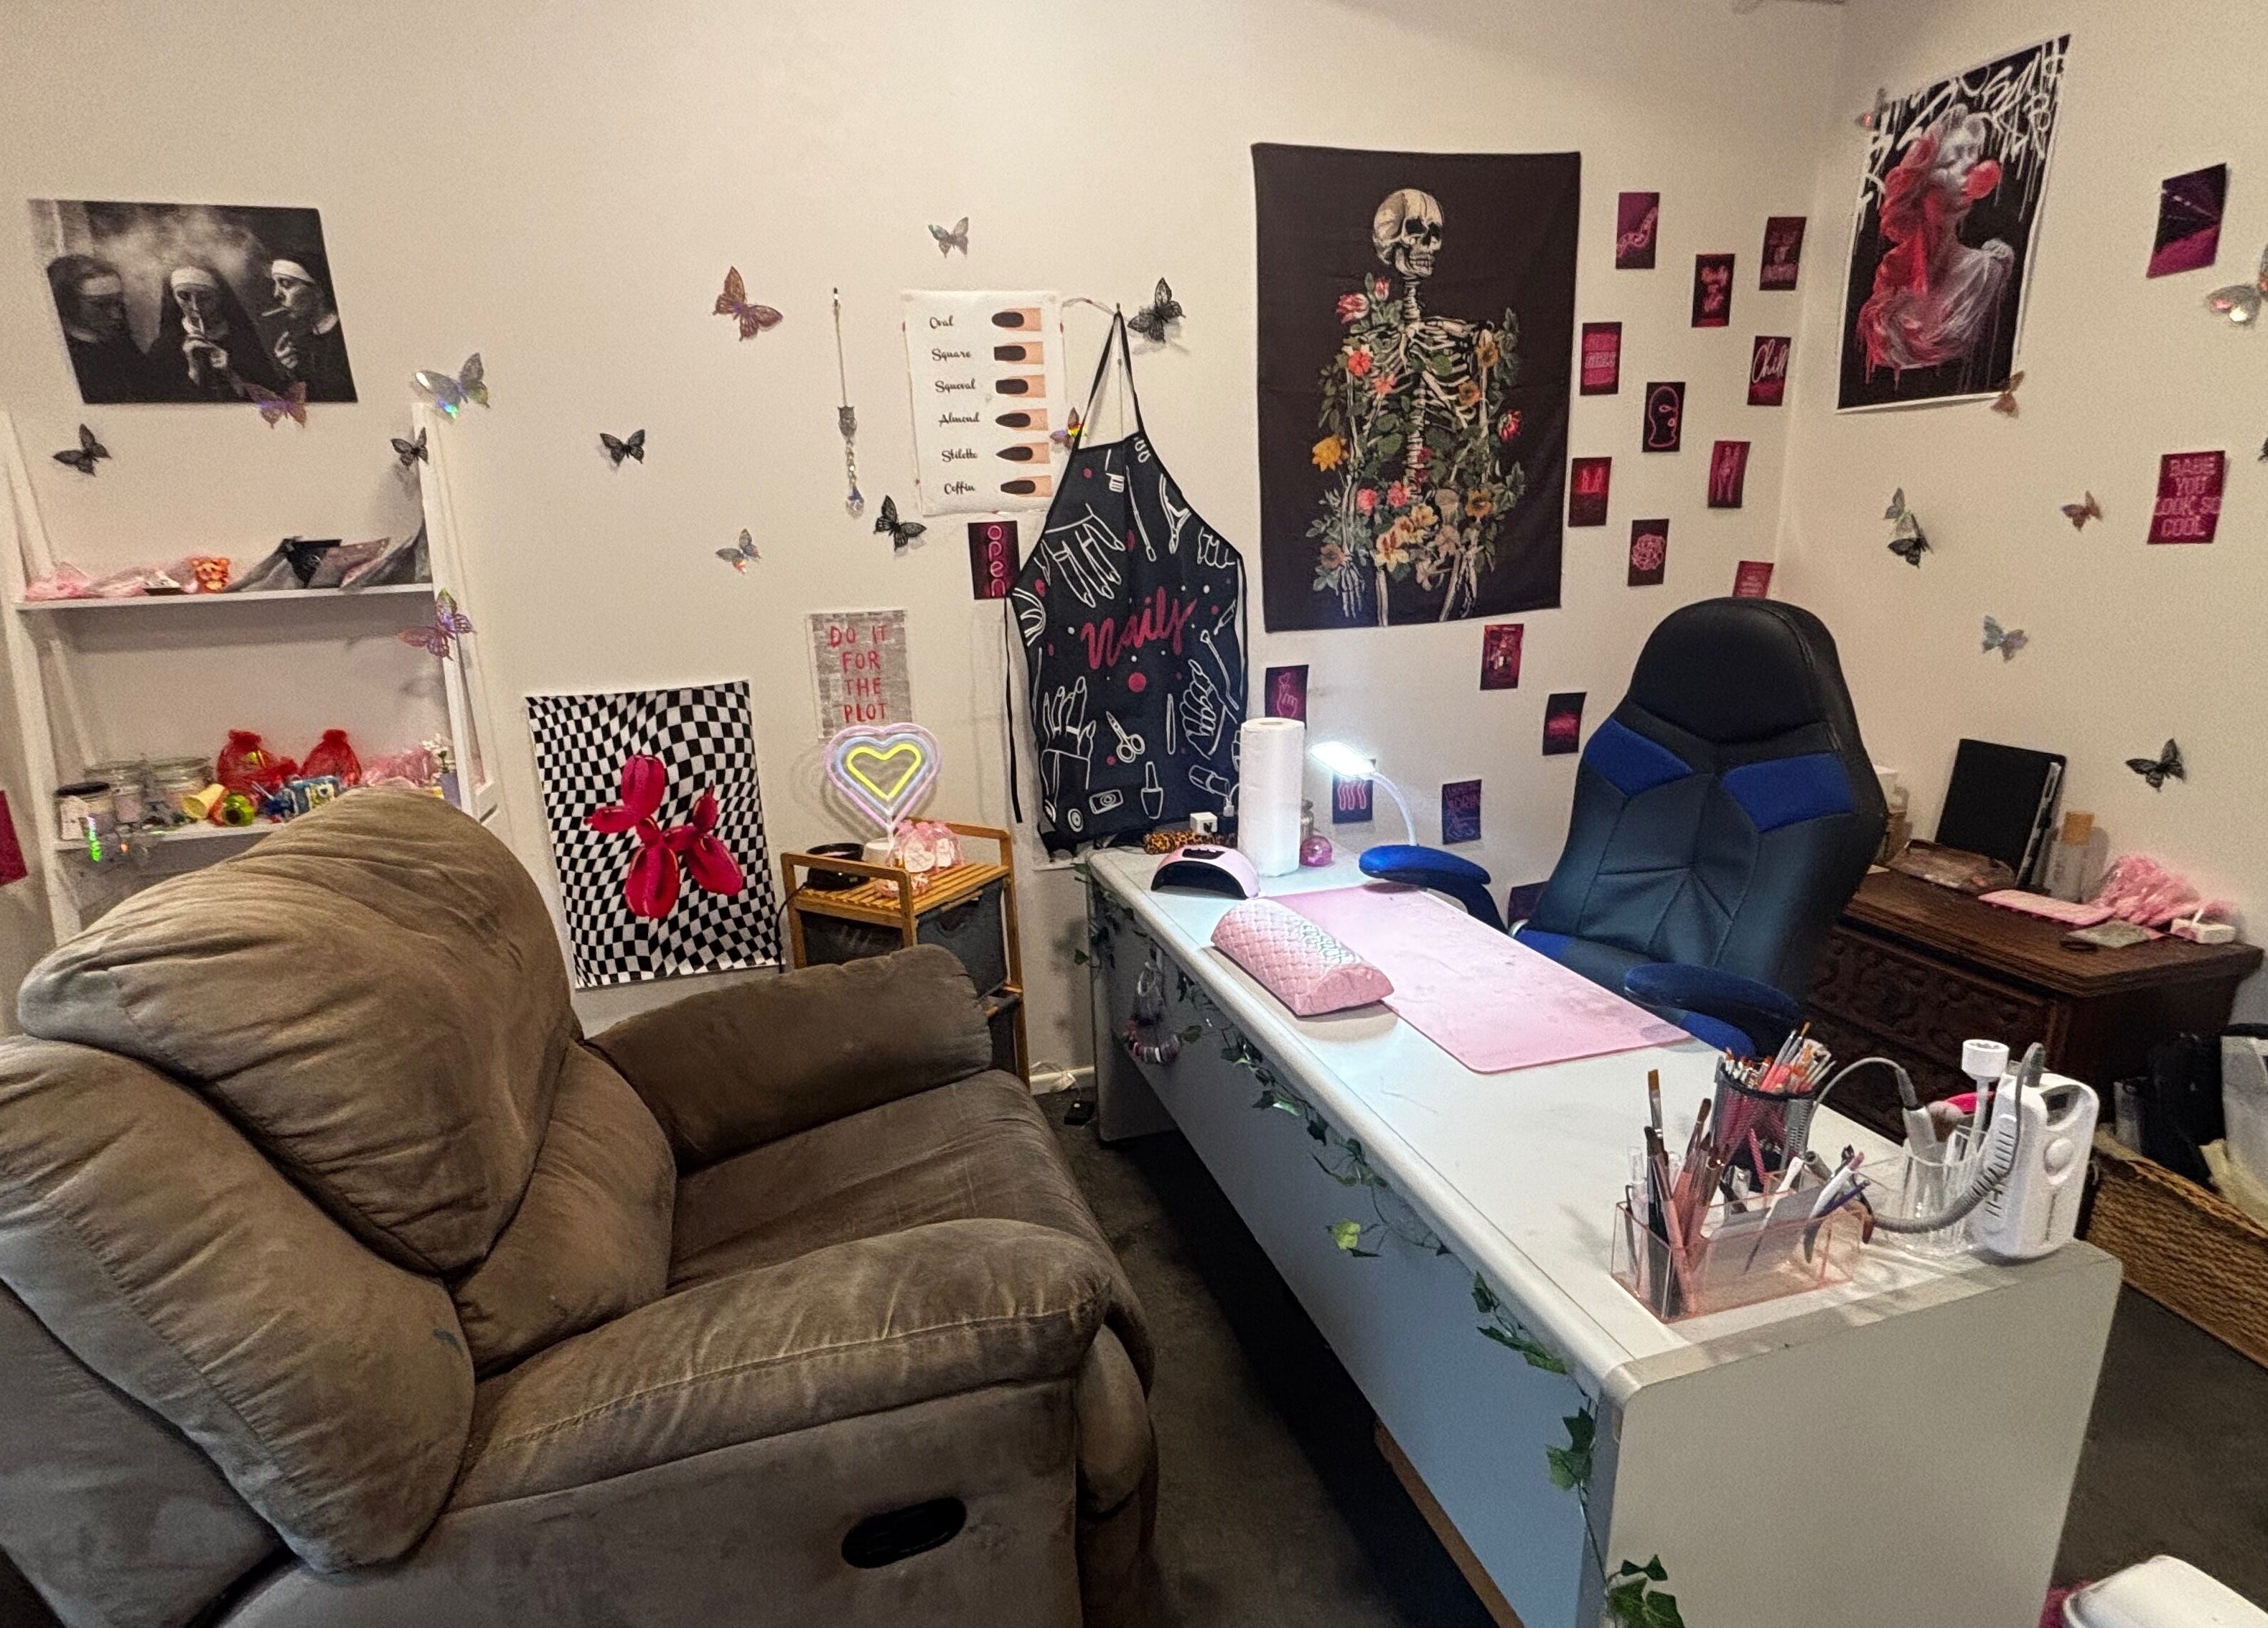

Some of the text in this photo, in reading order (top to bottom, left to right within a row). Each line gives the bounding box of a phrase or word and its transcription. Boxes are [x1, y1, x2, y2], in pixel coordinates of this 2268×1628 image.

[929, 315, 954, 329] Oval
[932, 348, 971, 362] Square
[1752, 339, 1787, 383] Chill
[935, 378, 975, 393] Squoval
[938, 412, 980, 427] Almond
[942, 449, 978, 463] Stiletto
[944, 480, 976, 495] Coffin
[2175, 476, 2207, 496] YOU
[2161, 515, 2206, 537] COOL
[829, 625, 887, 647] DO IT
[841, 651, 881, 673] FOR
[844, 678, 881, 697] THE
[843, 703, 888, 724] PLOT
